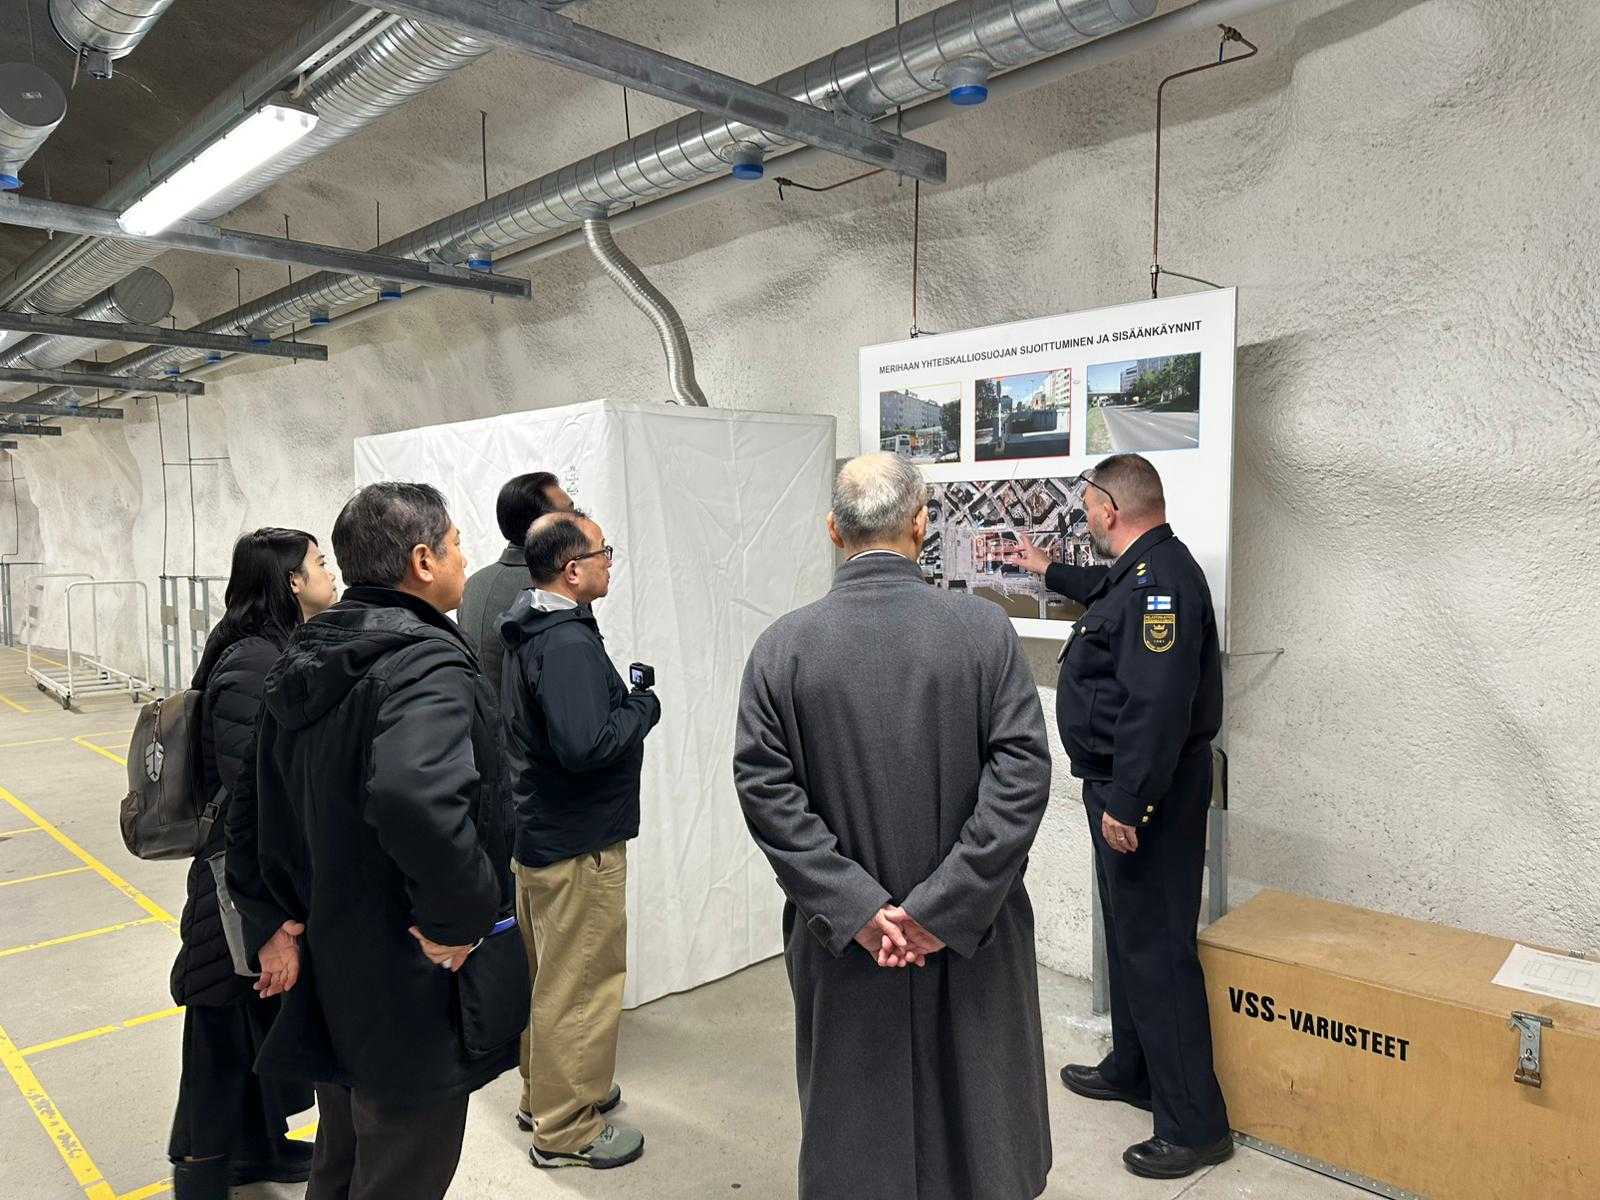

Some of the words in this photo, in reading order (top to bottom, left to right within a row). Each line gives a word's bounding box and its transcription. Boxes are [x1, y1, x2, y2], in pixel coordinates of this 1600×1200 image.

[879, 359, 920, 375] MERIHAAN
[921, 346, 1018, 368] YHTEISKALLIOSUOJAN
[1020, 336, 1094, 355] SIJOITTUMINEN
[1096, 333, 1110, 344] JA
[1112, 320, 1202, 343] SISÄÄNKÄYNNIT
[1228, 986, 1410, 1062] VSS-VARUSTEET
